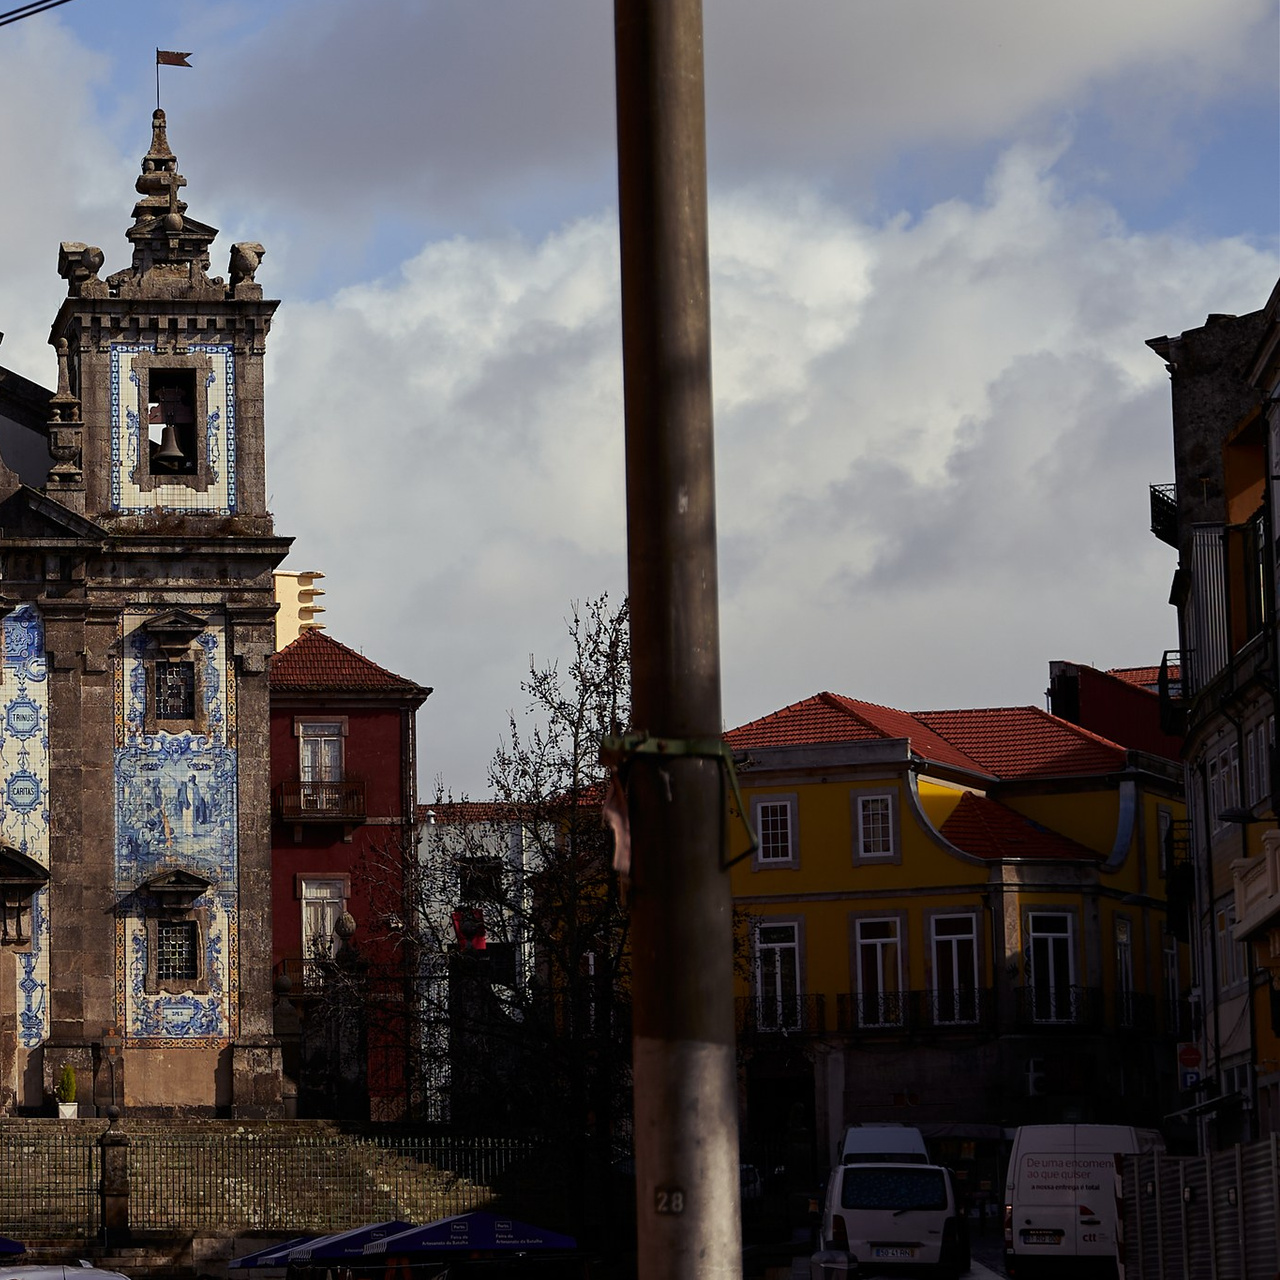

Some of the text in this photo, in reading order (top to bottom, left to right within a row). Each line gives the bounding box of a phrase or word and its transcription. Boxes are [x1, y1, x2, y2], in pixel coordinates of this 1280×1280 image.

[12, 713, 34, 722] TRINUS
[12, 787, 35, 796] CARITAS
[1186, 1073, 1197, 1088] P
[1027, 1158, 1040, 1168] De
[1042, 1159, 1064, 1168] uma
[1027, 1169, 1091, 1180] ao que quiser
[657, 1191, 684, 1212] 28
